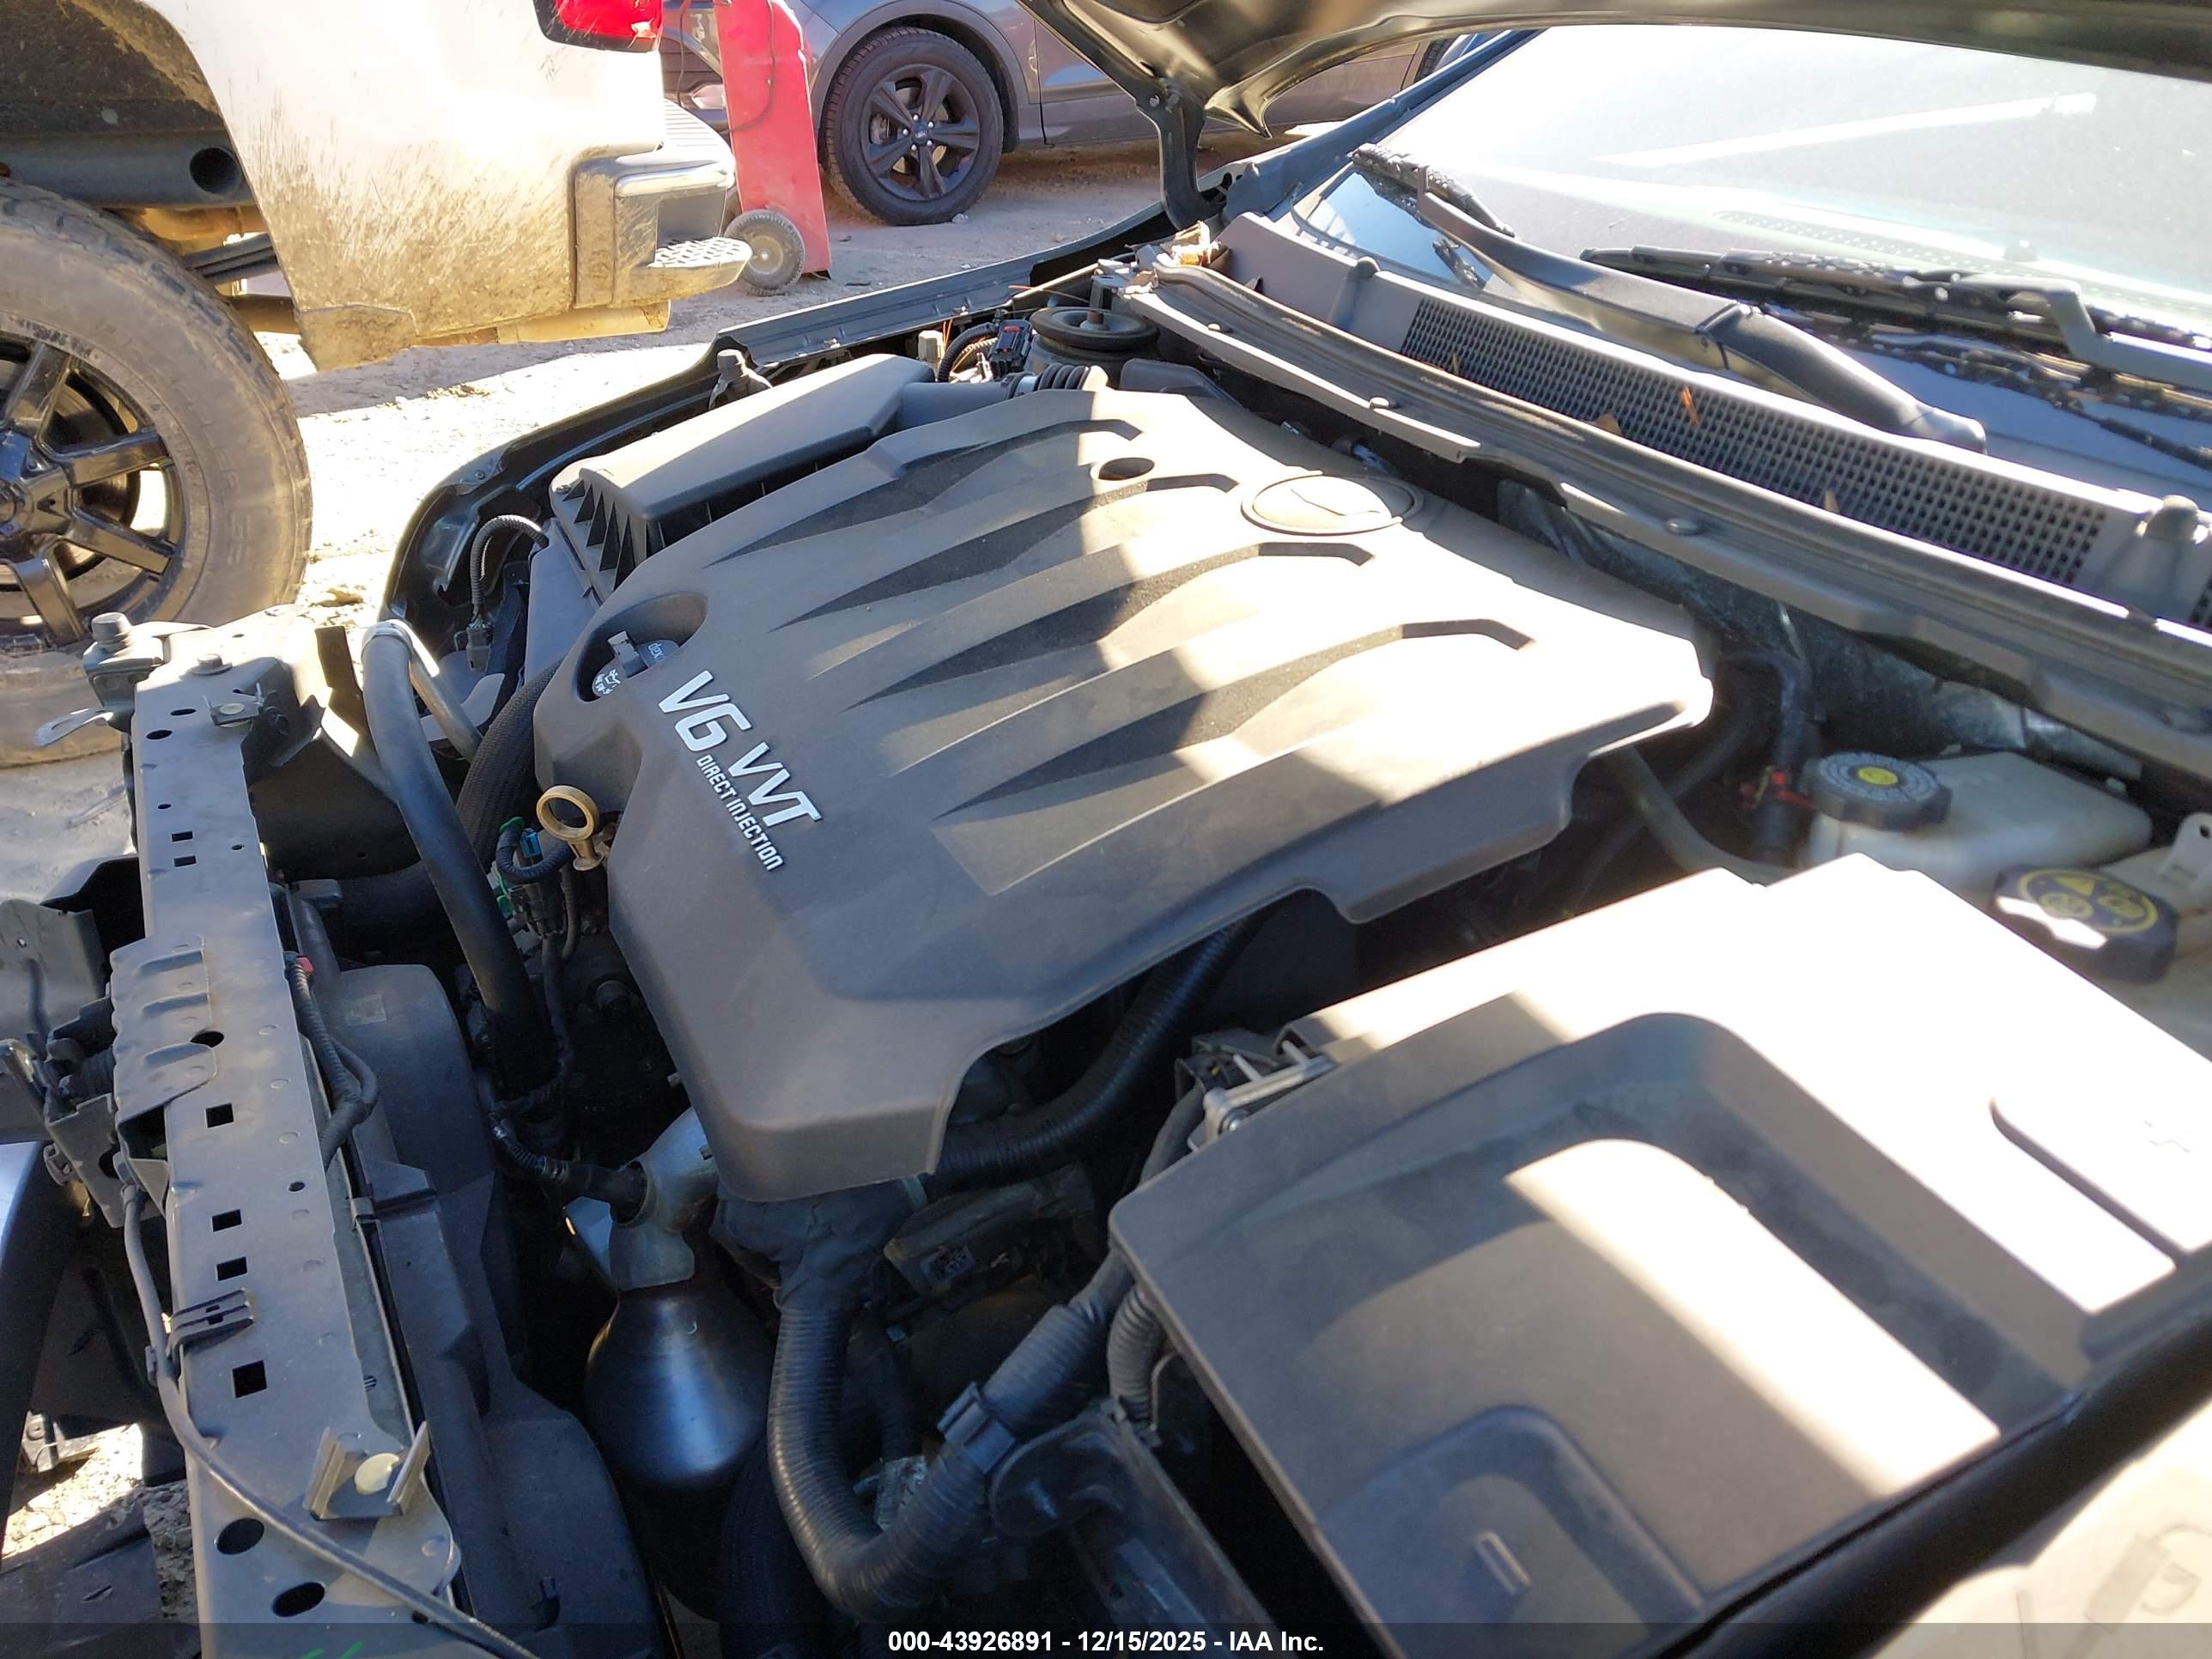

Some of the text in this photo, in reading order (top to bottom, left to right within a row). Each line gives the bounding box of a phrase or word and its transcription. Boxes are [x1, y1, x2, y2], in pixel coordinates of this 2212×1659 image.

[658, 670, 822, 826] V6 VVT
[696, 754, 784, 872] DIRECT INJECTION
